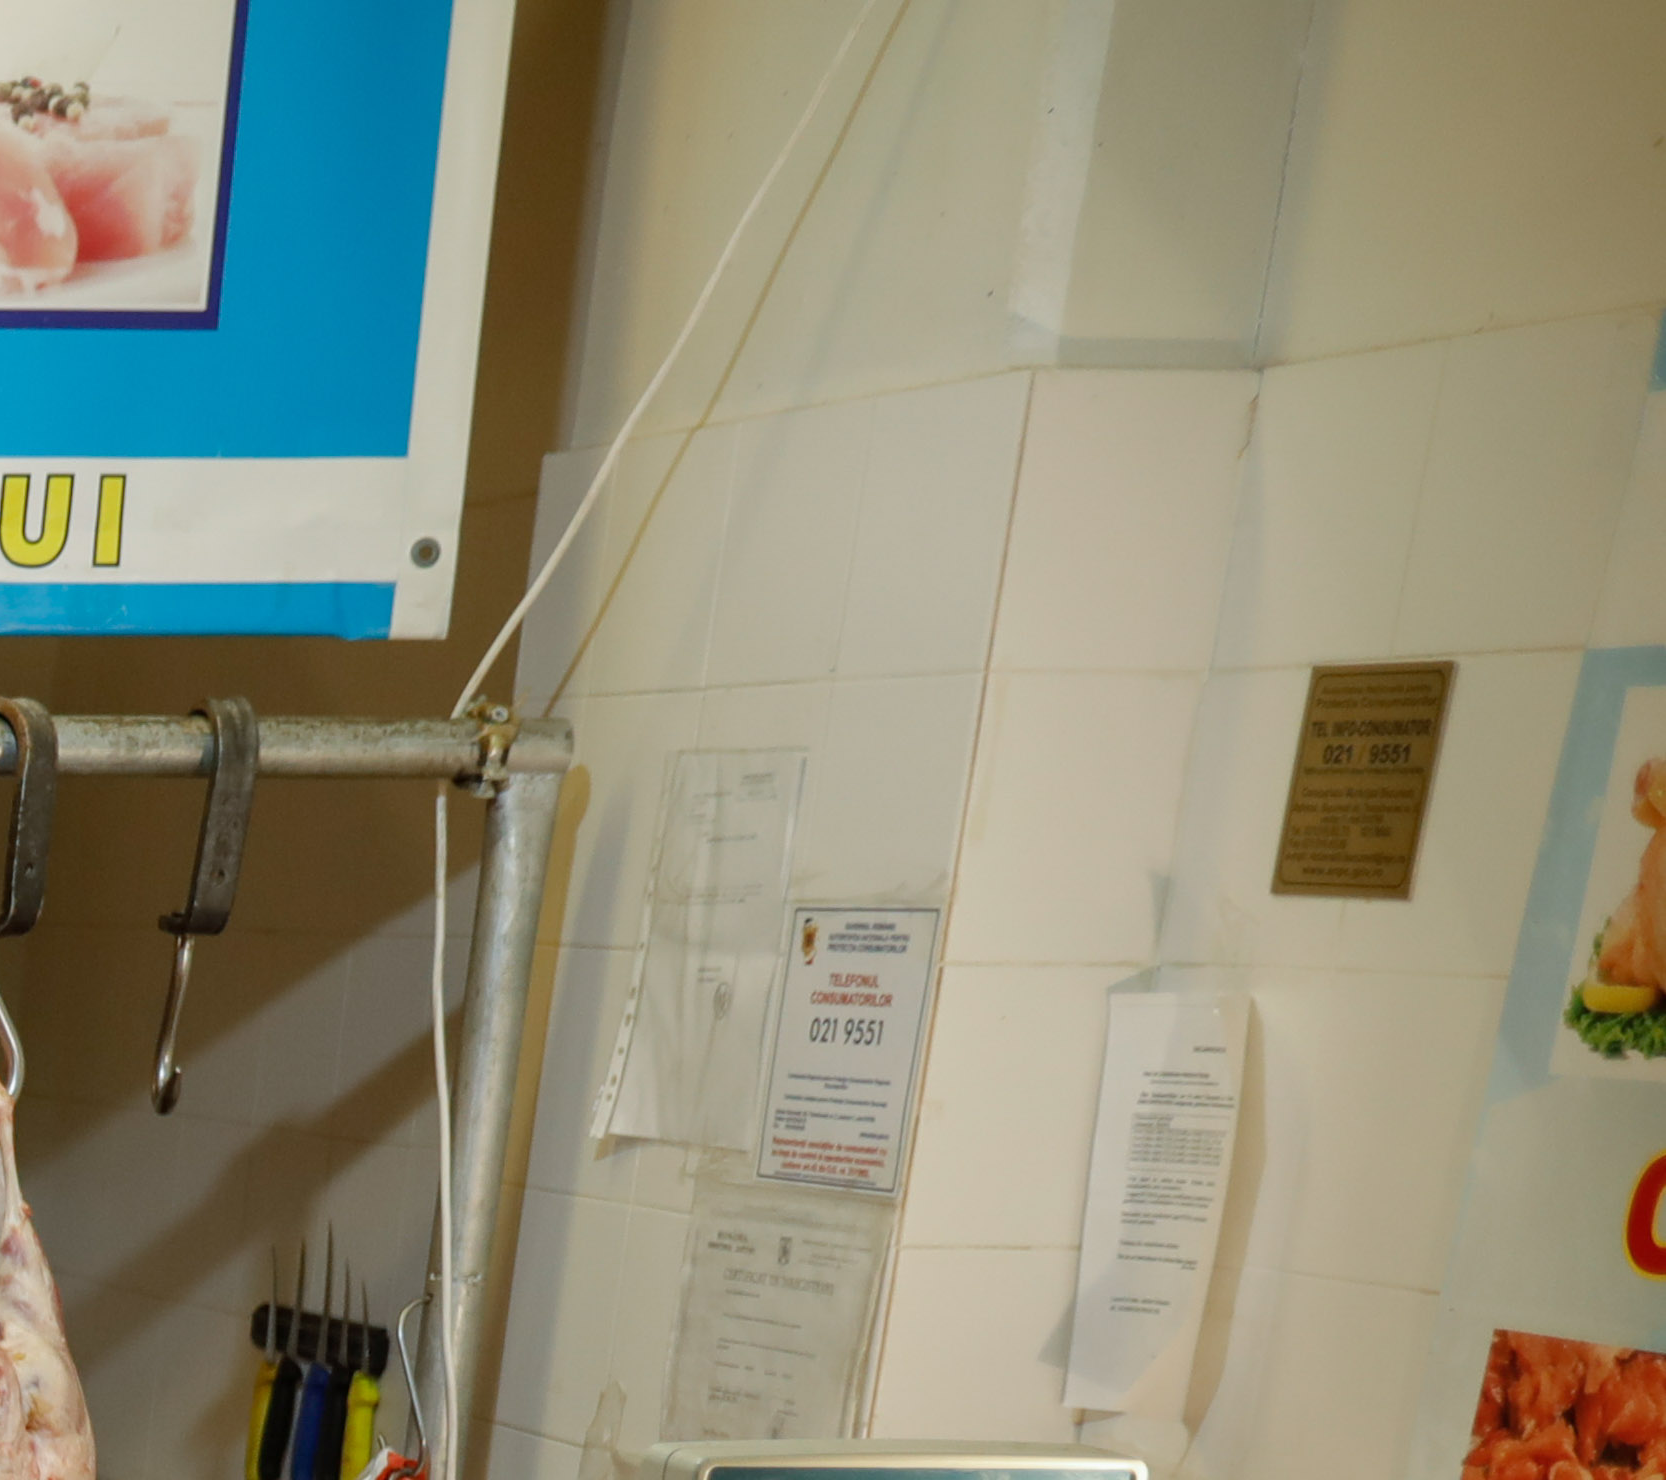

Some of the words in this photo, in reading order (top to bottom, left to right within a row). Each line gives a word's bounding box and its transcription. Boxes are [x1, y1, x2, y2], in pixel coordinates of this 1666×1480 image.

[1322, 744, 1355, 765] 021
[1368, 743, 1412, 765] 9551
[830, 972, 879, 989] TELEFONUL
[810, 991, 893, 1008] CONSUMATORILOR
[809, 1017, 838, 1045] 021
[843, 1018, 885, 1046] 9551
